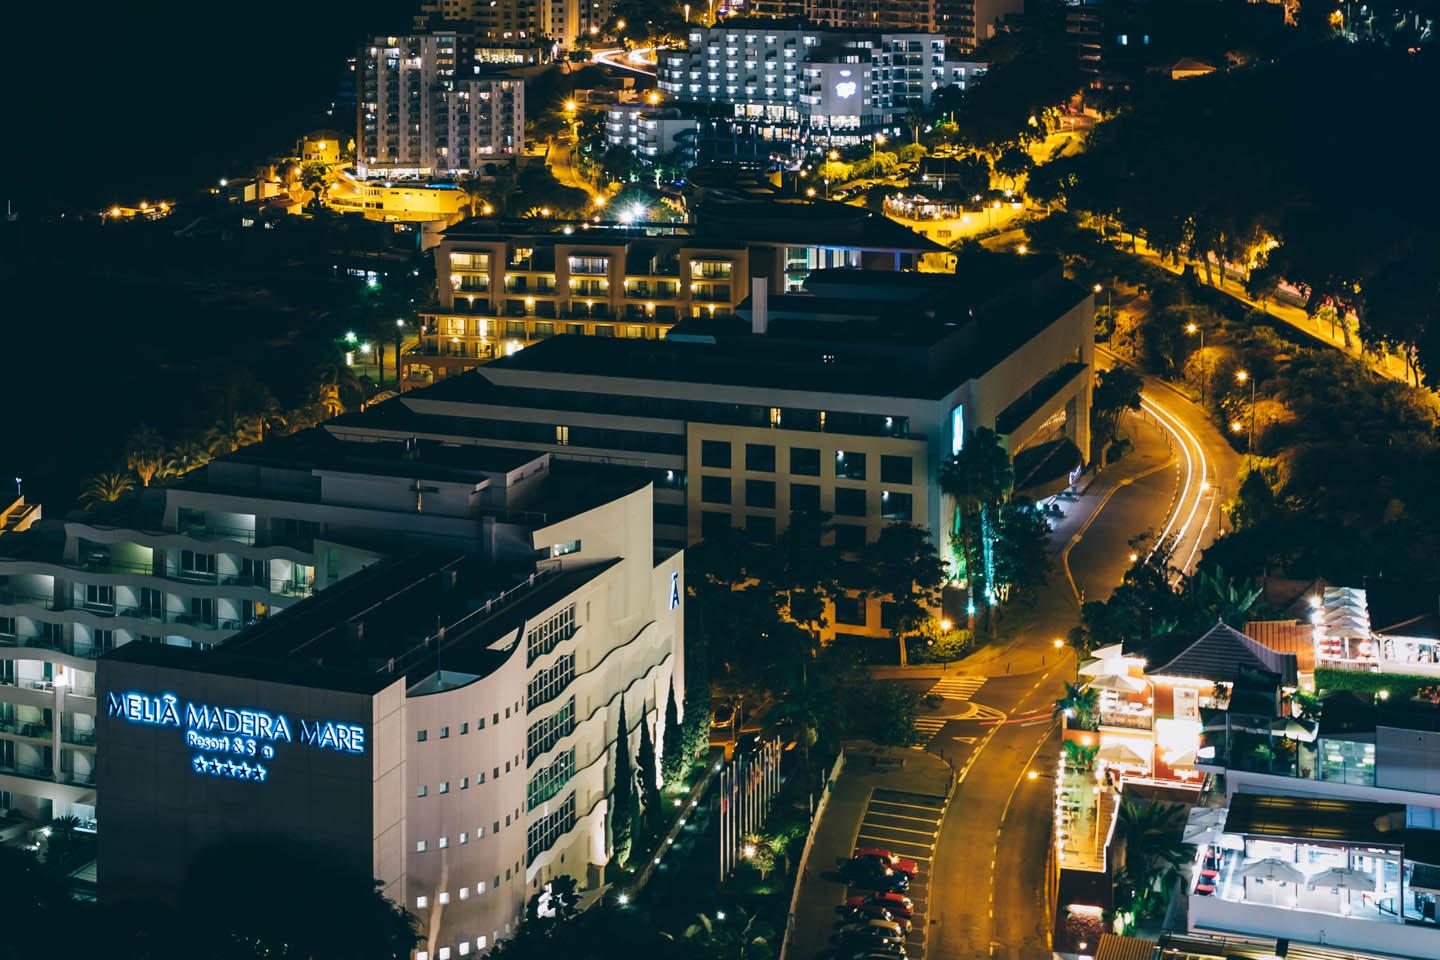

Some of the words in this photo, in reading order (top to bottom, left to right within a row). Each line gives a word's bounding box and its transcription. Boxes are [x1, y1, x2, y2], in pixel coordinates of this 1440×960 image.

[187, 702, 291, 742] MADEIRA
[300, 719, 364, 752] MARE
[187, 730, 229, 752] Resort
[232, 737, 245, 753] &
[246, 739, 274, 758] Sa
